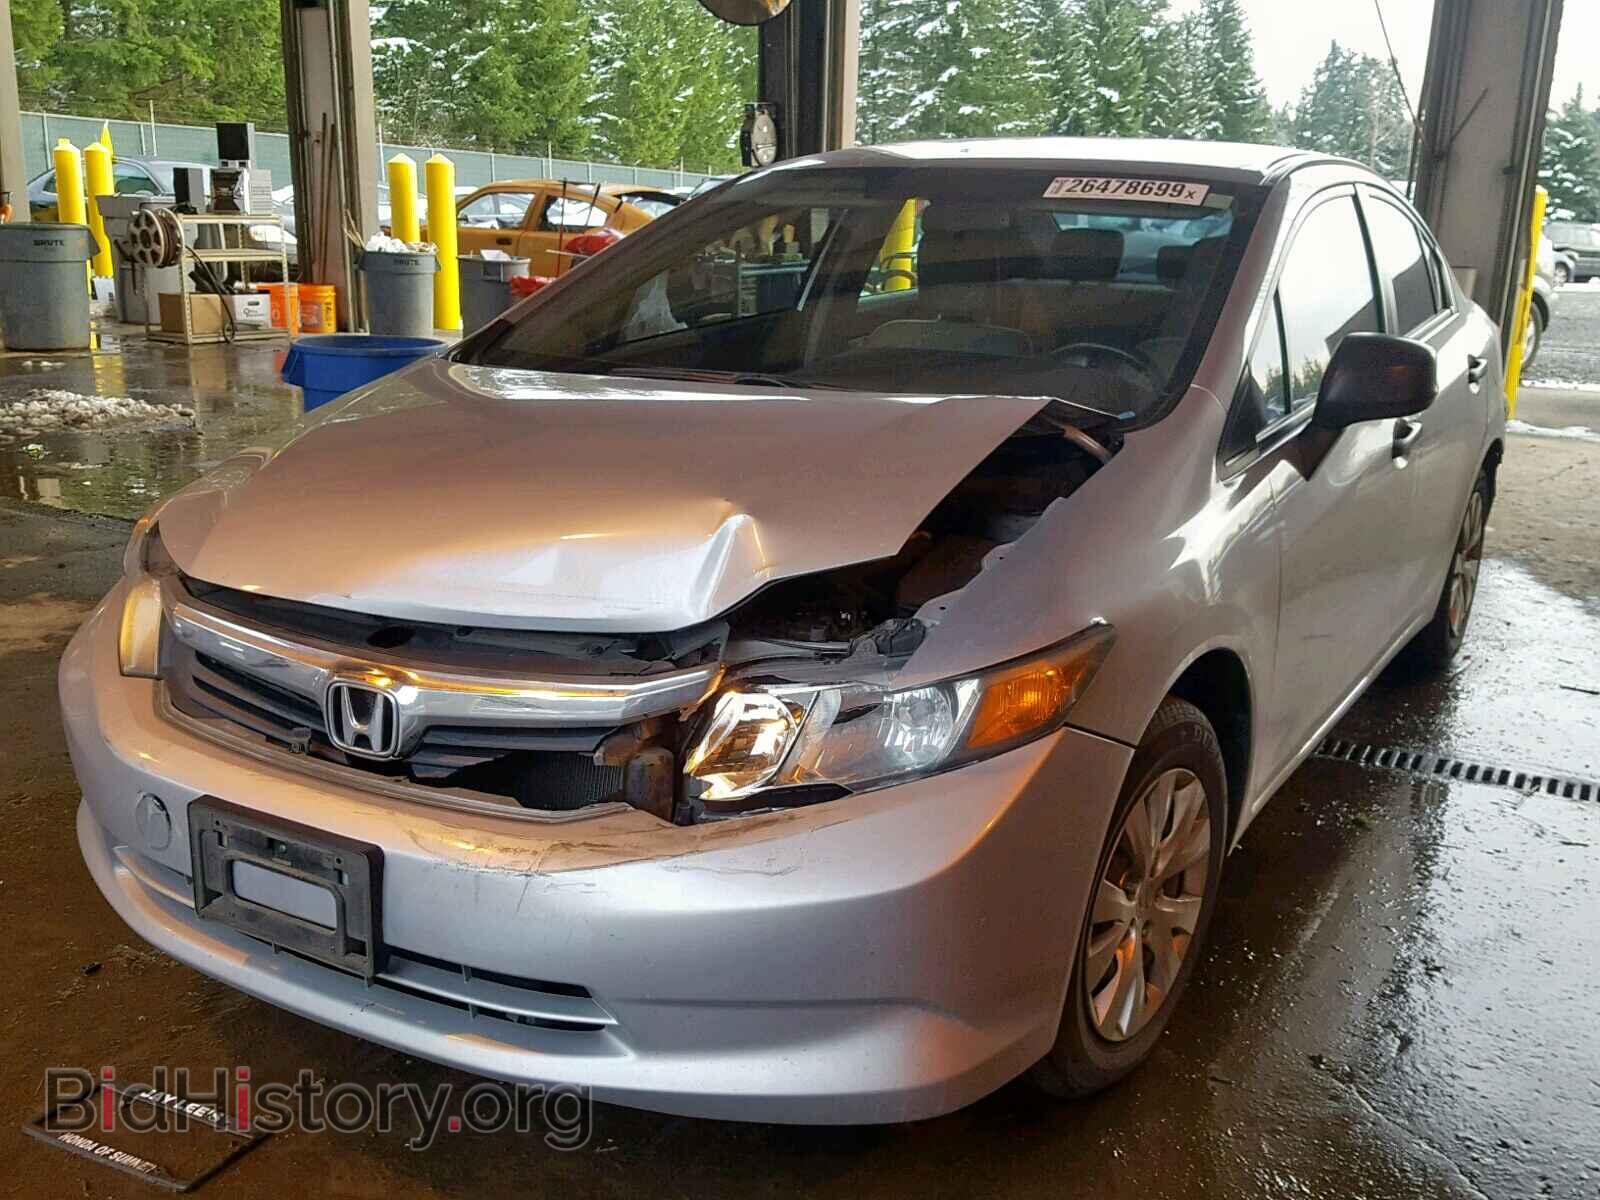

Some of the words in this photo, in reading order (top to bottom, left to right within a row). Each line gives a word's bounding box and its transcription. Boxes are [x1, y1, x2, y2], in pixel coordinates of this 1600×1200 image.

[1065, 178, 1186, 198] 26478699
[57, 1132, 98, 1151] HONDA
[94, 1144, 114, 1159] OF
